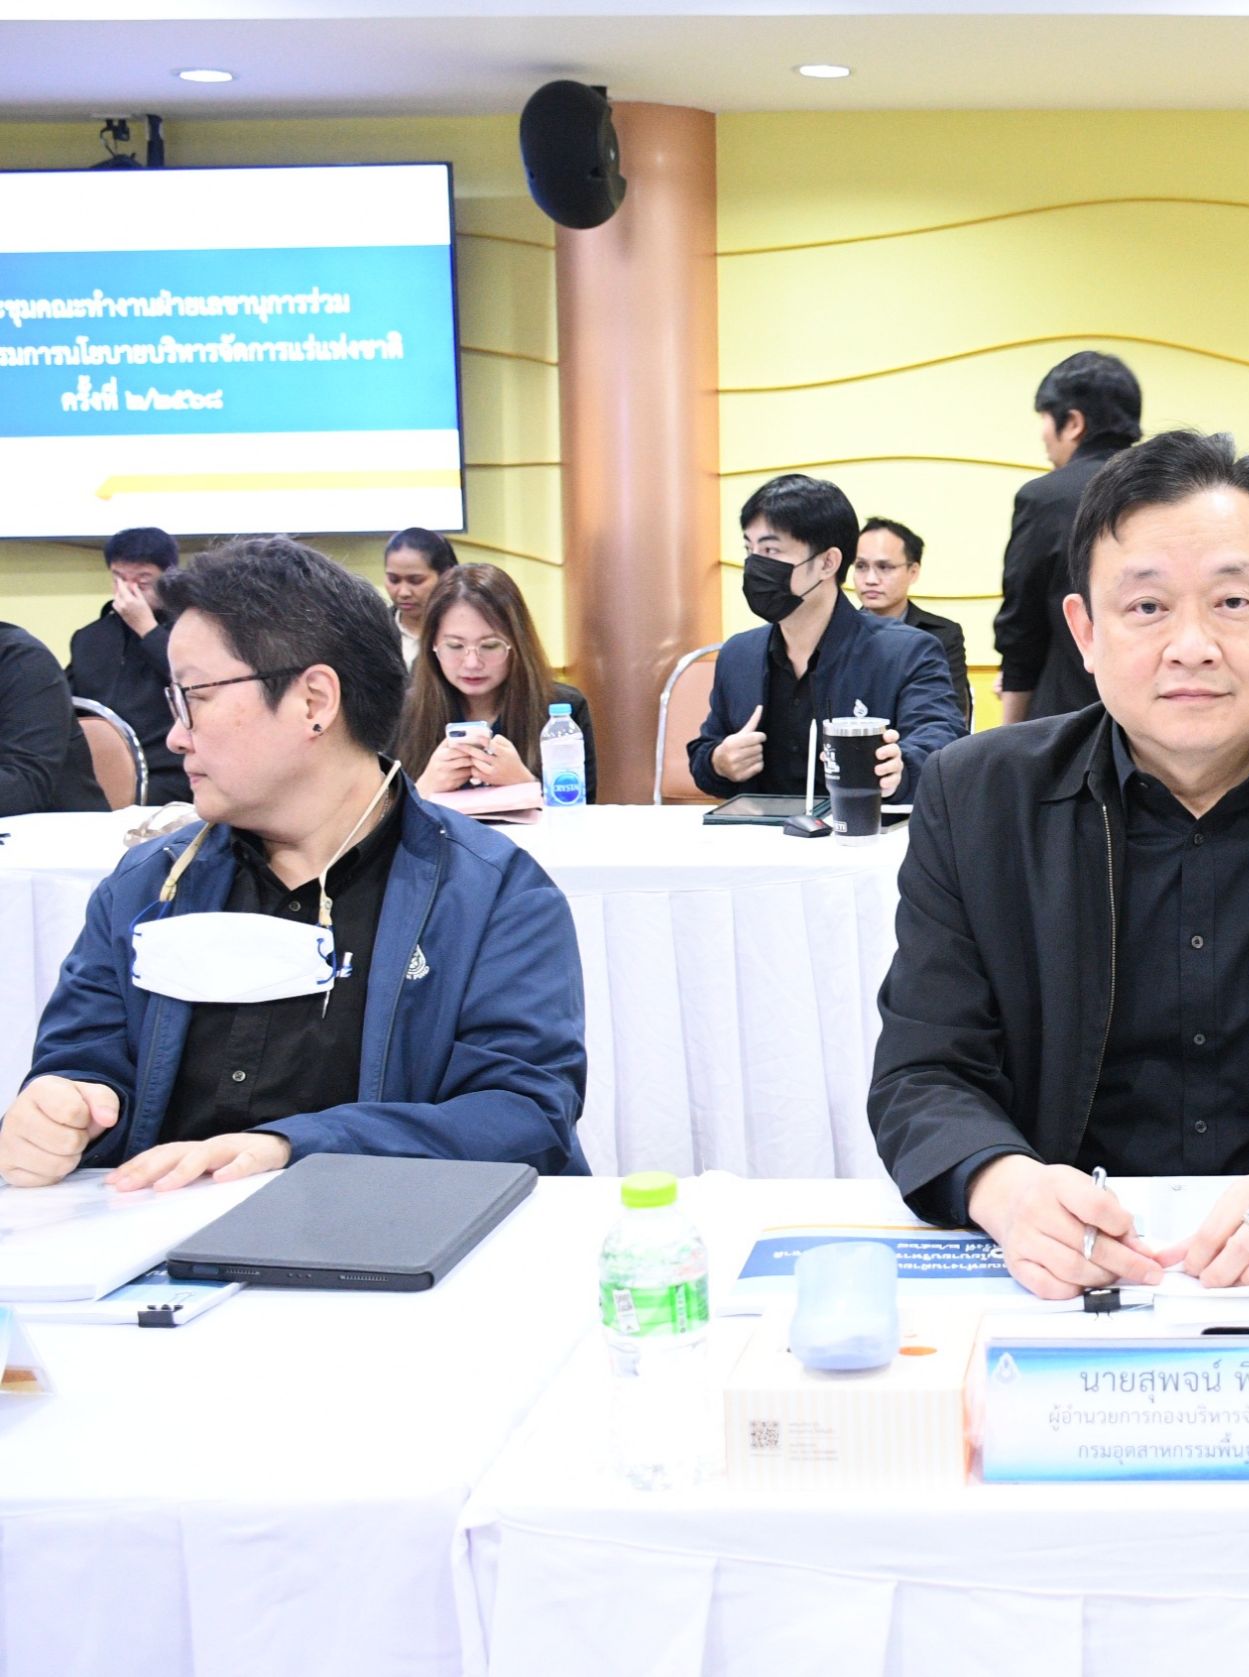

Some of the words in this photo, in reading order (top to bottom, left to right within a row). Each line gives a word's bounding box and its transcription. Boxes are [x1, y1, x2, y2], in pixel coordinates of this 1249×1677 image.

[61, 375, 119, 411] ครั้งที่
[1079, 1359, 1222, 1403] นายสุพจน์
